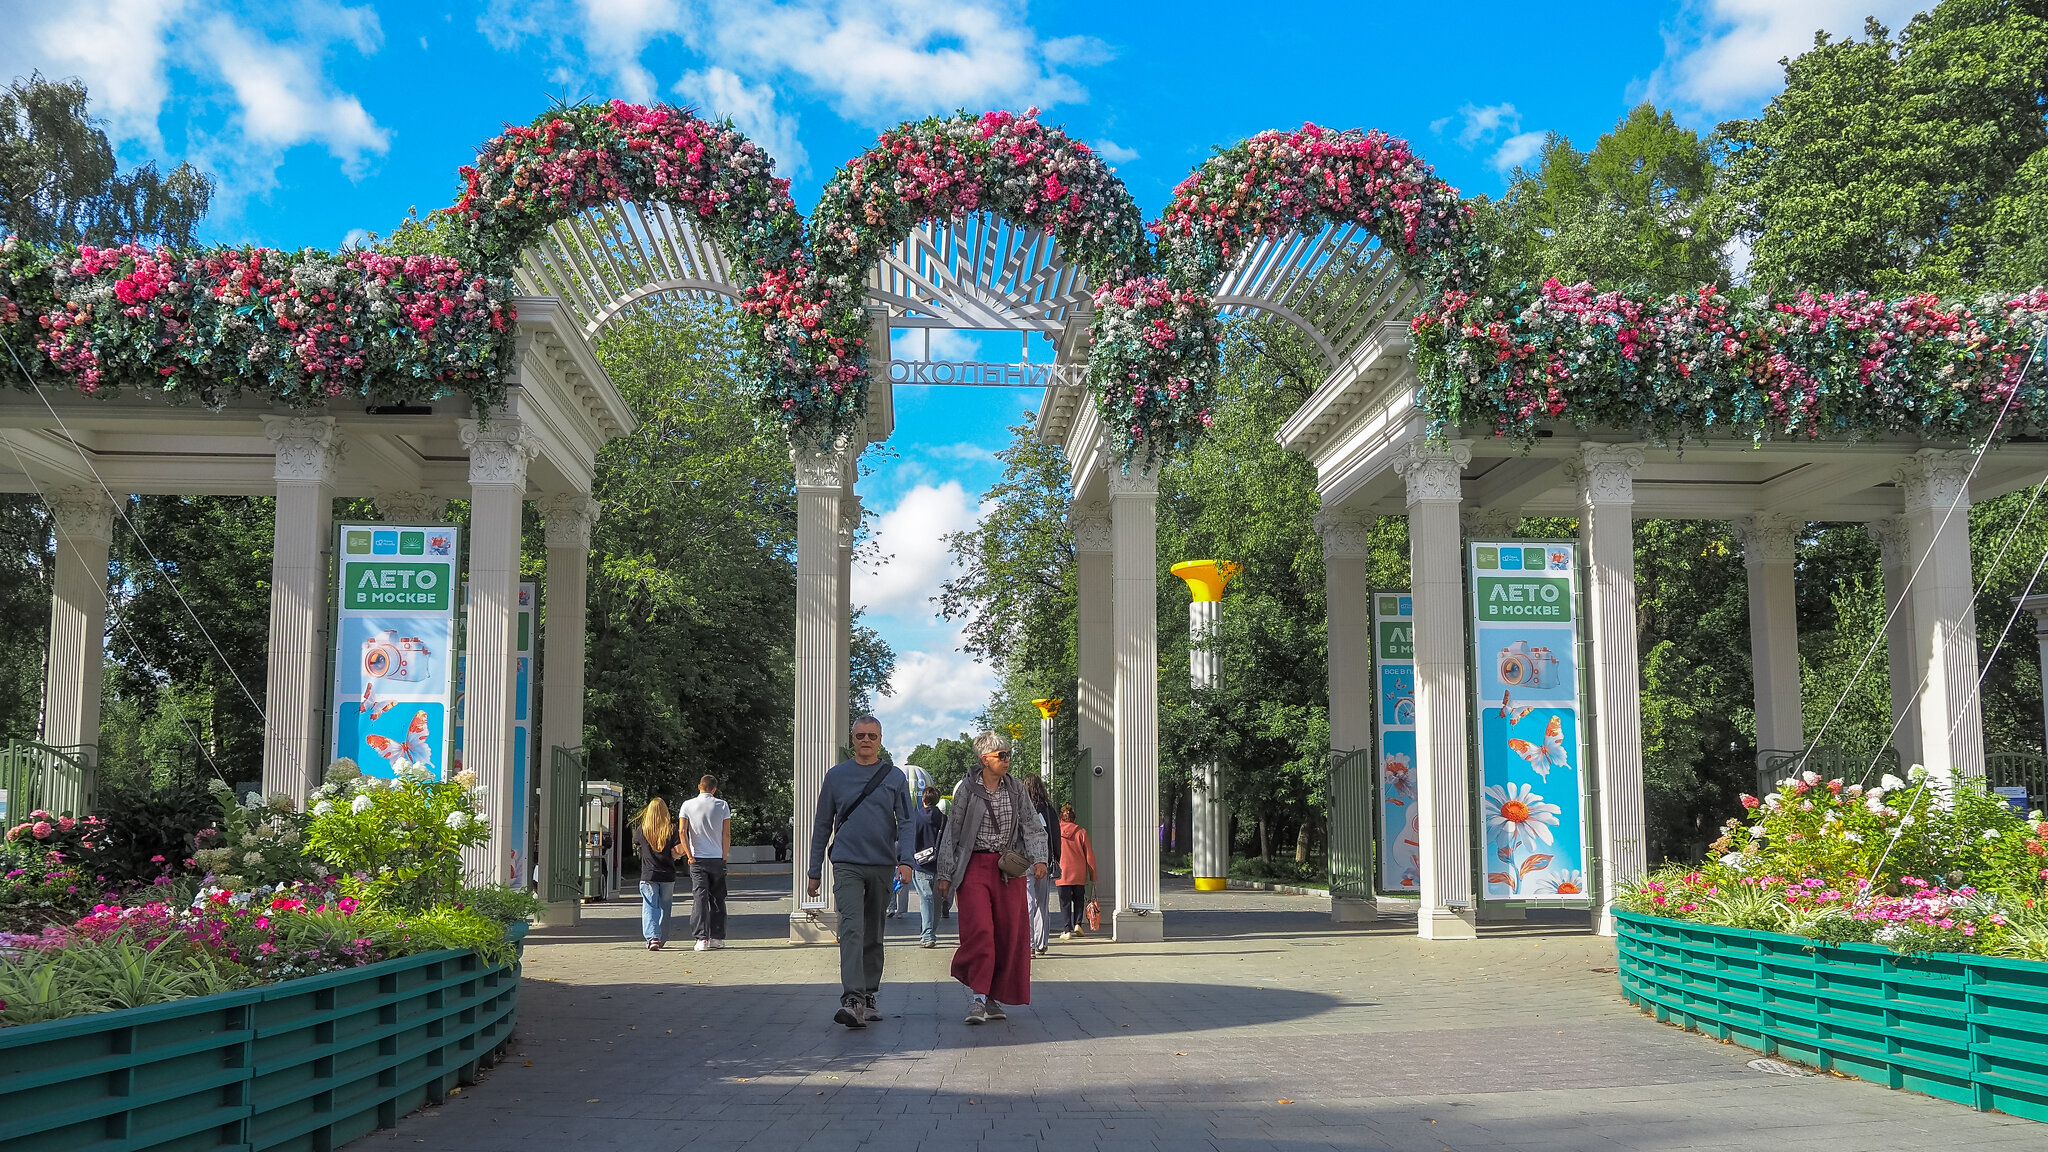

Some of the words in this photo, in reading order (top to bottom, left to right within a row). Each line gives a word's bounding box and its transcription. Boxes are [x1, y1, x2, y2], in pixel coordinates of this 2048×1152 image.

[358, 569, 437, 590] ЛЕТО
[356, 592, 367, 603] В
[372, 592, 436, 604] МОСКВЕ
[1489, 583, 1560, 603] ЛЕТО
[1489, 605, 1498, 615] В
[1502, 605, 1560, 616] МОСКВЕ
[1389, 645, 1398, 654] В
